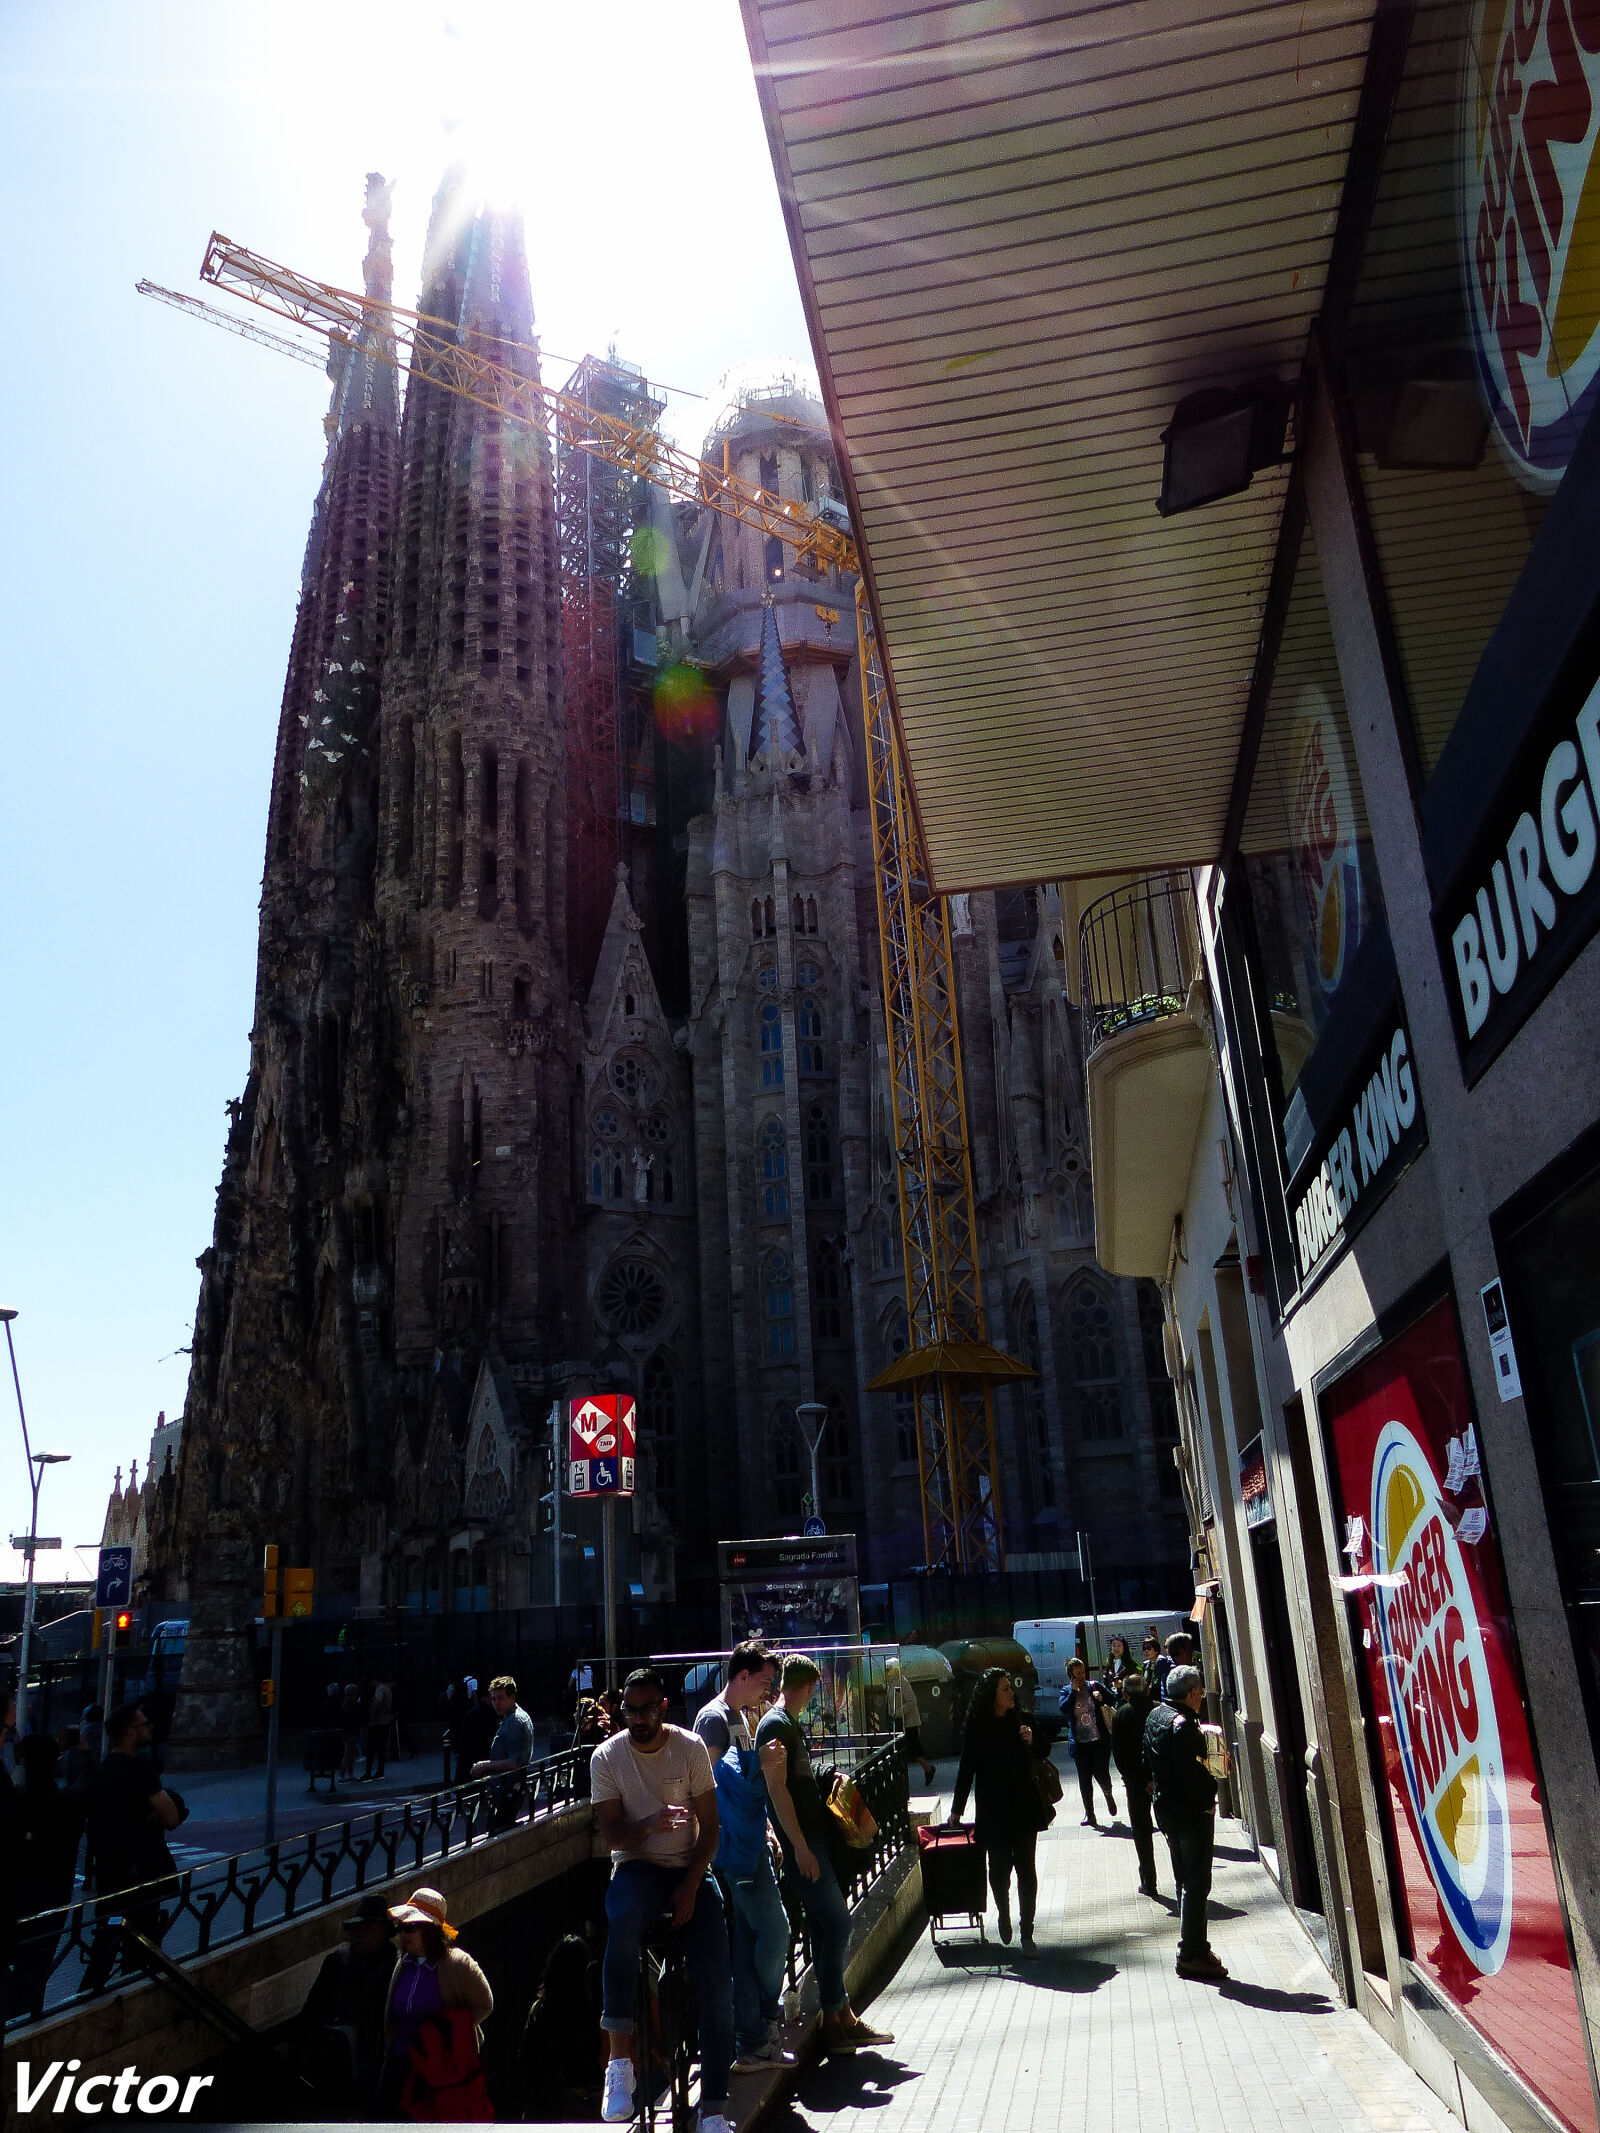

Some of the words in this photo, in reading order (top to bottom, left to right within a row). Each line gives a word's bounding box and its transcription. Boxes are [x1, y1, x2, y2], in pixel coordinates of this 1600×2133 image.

[1294, 1126, 1359, 1277] BURGER
[1352, 1027, 1416, 1187] KING
[581, 1412, 597, 1433] M
[779, 1552, 810, 1561] Sagrada
[1388, 1515, 1454, 1692] BURGER
[1404, 1605, 1480, 1815] KING
